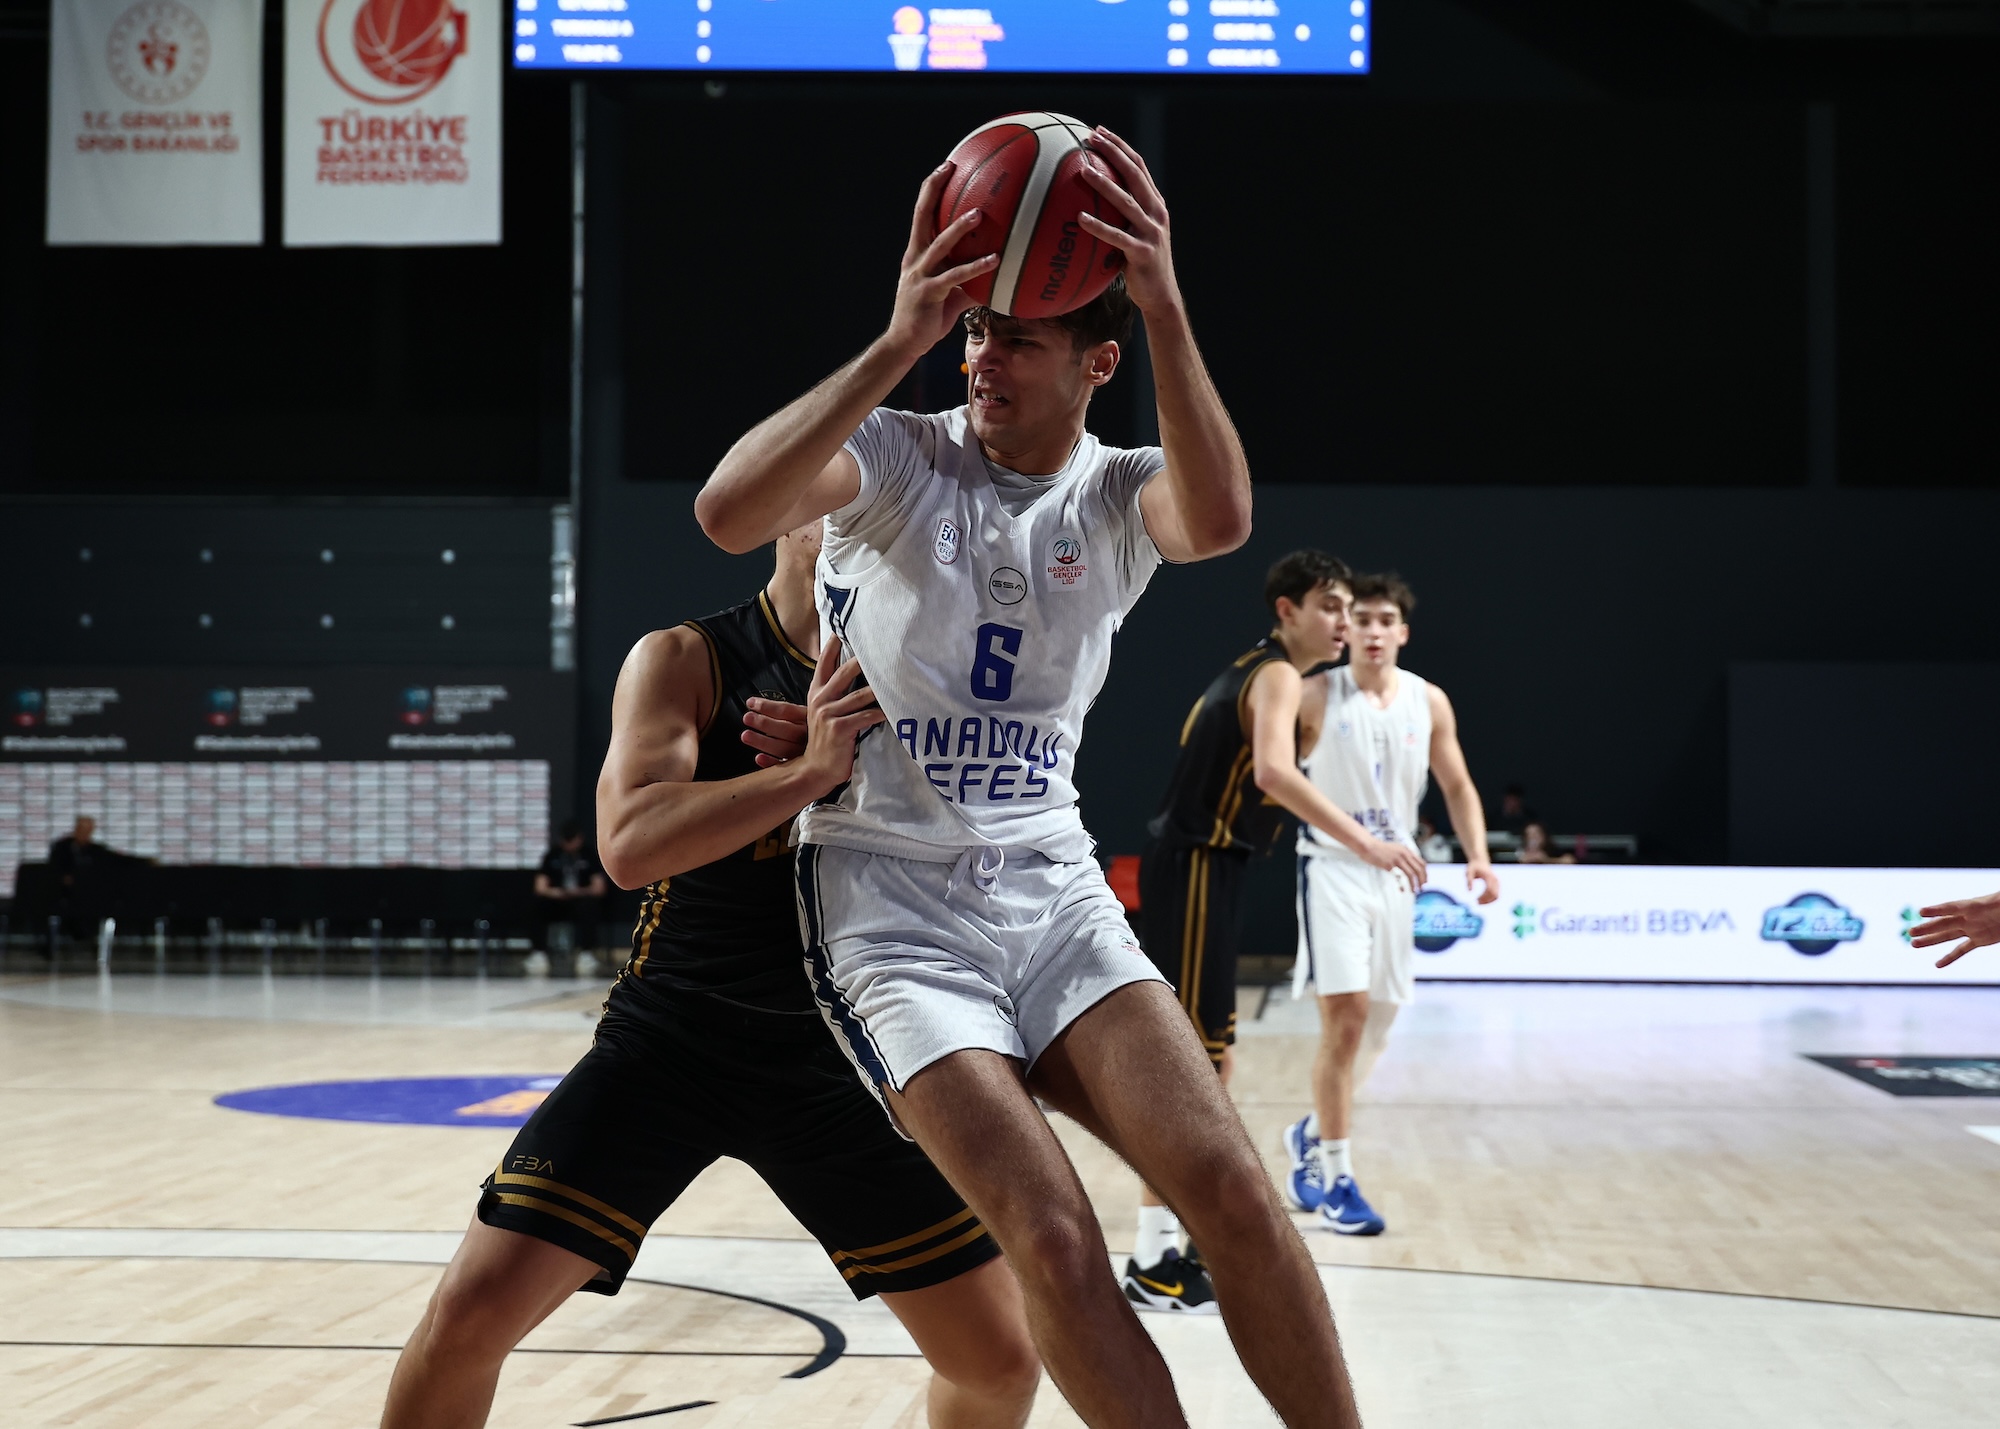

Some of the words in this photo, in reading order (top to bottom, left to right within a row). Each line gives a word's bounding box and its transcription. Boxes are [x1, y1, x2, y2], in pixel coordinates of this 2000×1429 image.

[208, 110, 233, 131] VE
[317, 109, 468, 143] TÜRKİYE
[317, 146, 467, 165] BASKETBOL
[1040, 221, 1079, 302] molten
[1047, 565, 1087, 573] BASKETBOL
[970, 622, 1023, 702] 6
[896, 716, 1065, 769] ANADOLU
[924, 763, 1049, 804] EFES
[1540, 906, 1640, 935] Garanti
[1648, 908, 1737, 935] BBVA
[511, 1155, 555, 1174] FBA
